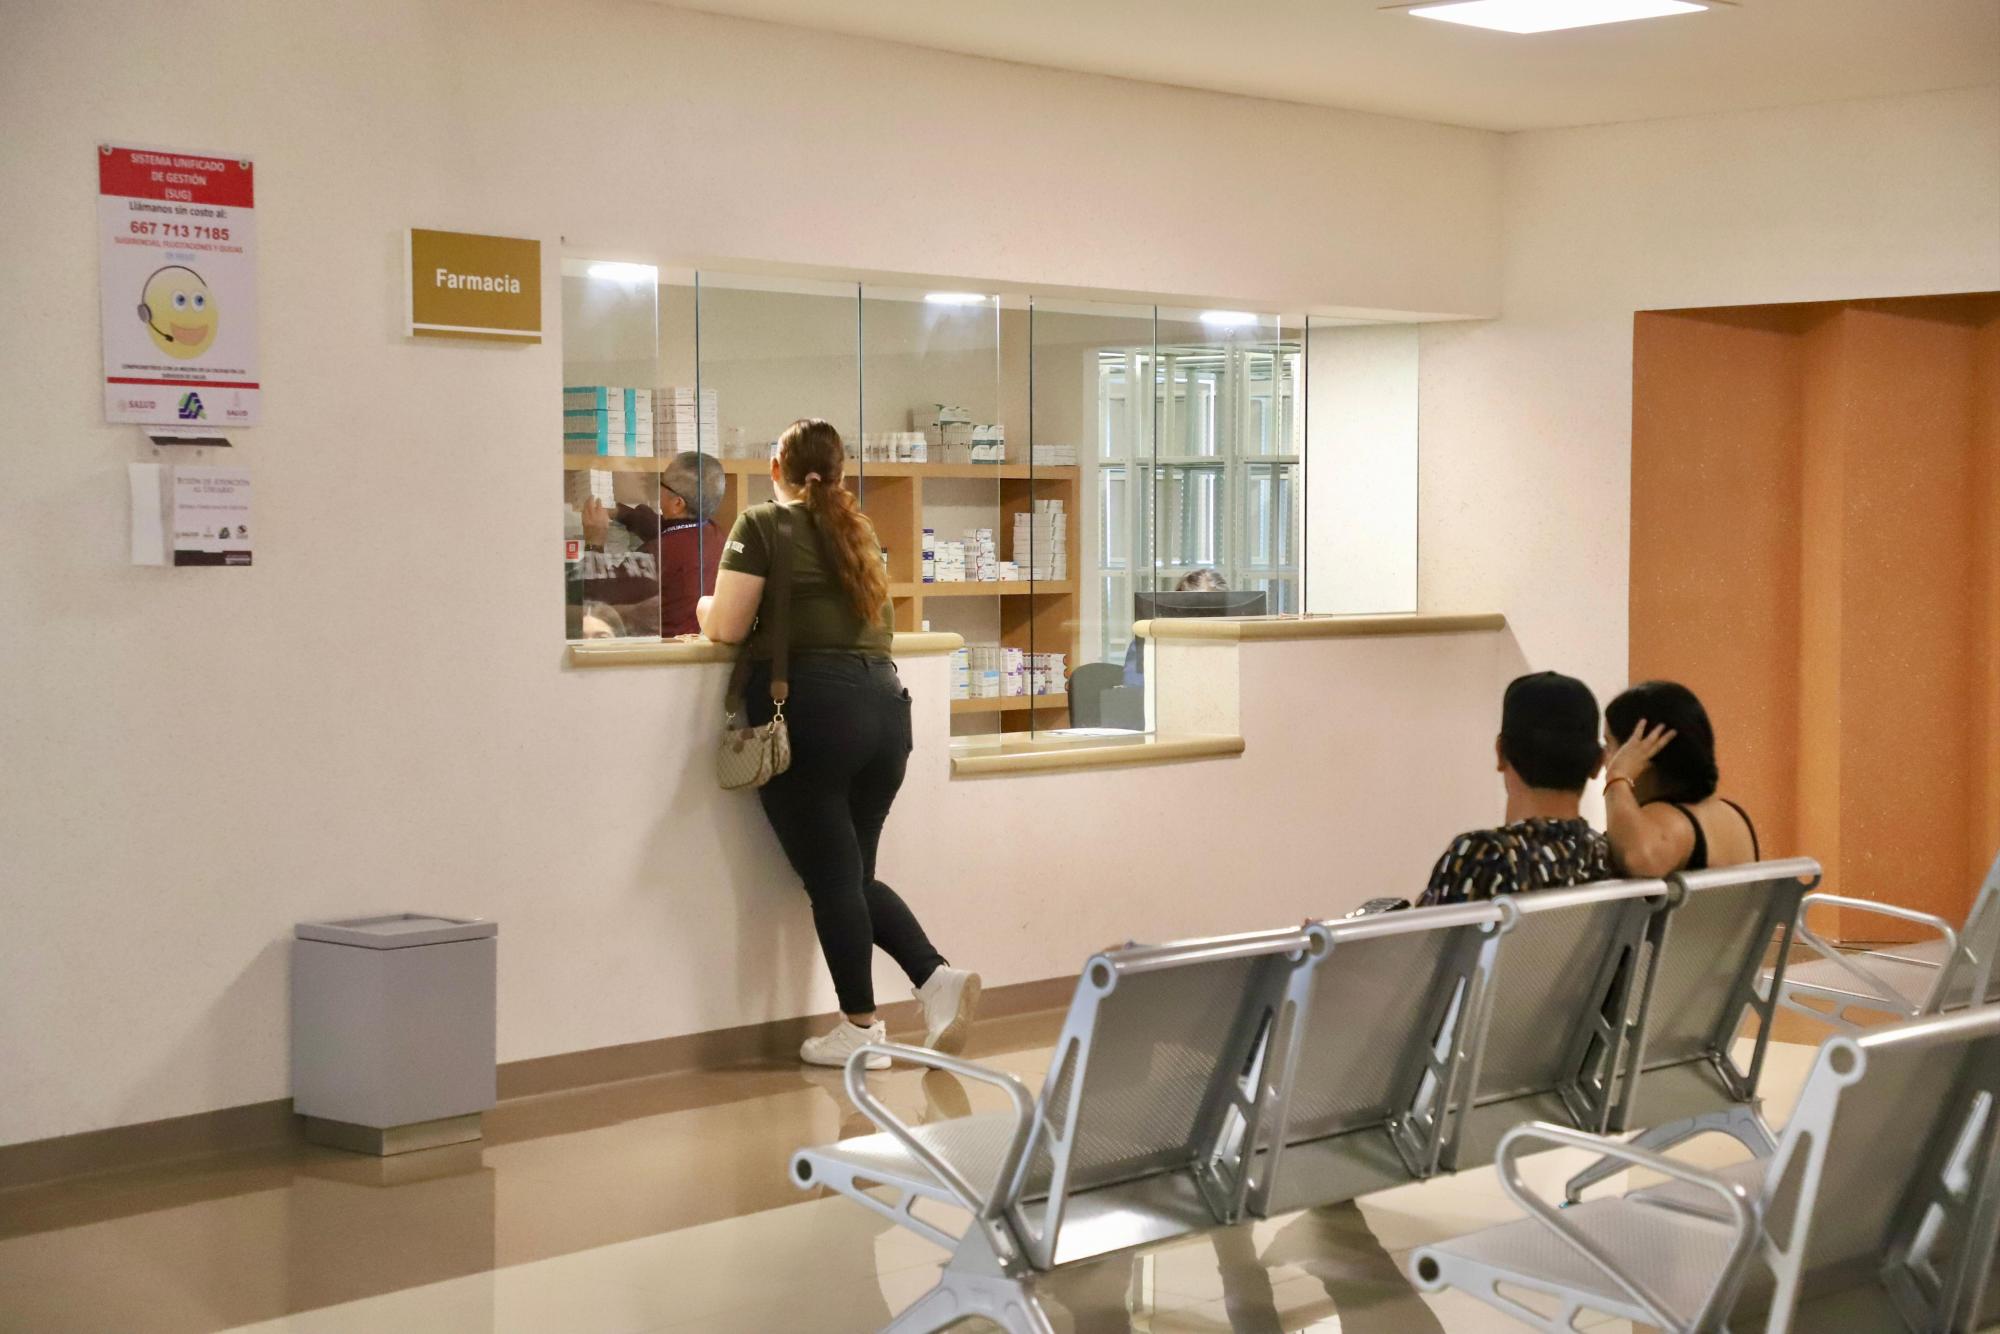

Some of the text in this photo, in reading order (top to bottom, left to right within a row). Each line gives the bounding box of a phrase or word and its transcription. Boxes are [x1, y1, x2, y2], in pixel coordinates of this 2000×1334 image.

[130, 153, 225, 172] SISTEMA UNIFICADO
[151, 171, 164, 182] DE
[175, 205, 188, 215] sin
[190, 207, 213, 218] costo
[130, 220, 230, 241] 667 713 7185
[436, 268, 521, 294] Farmacia
[128, 400, 157, 409] SALUD
